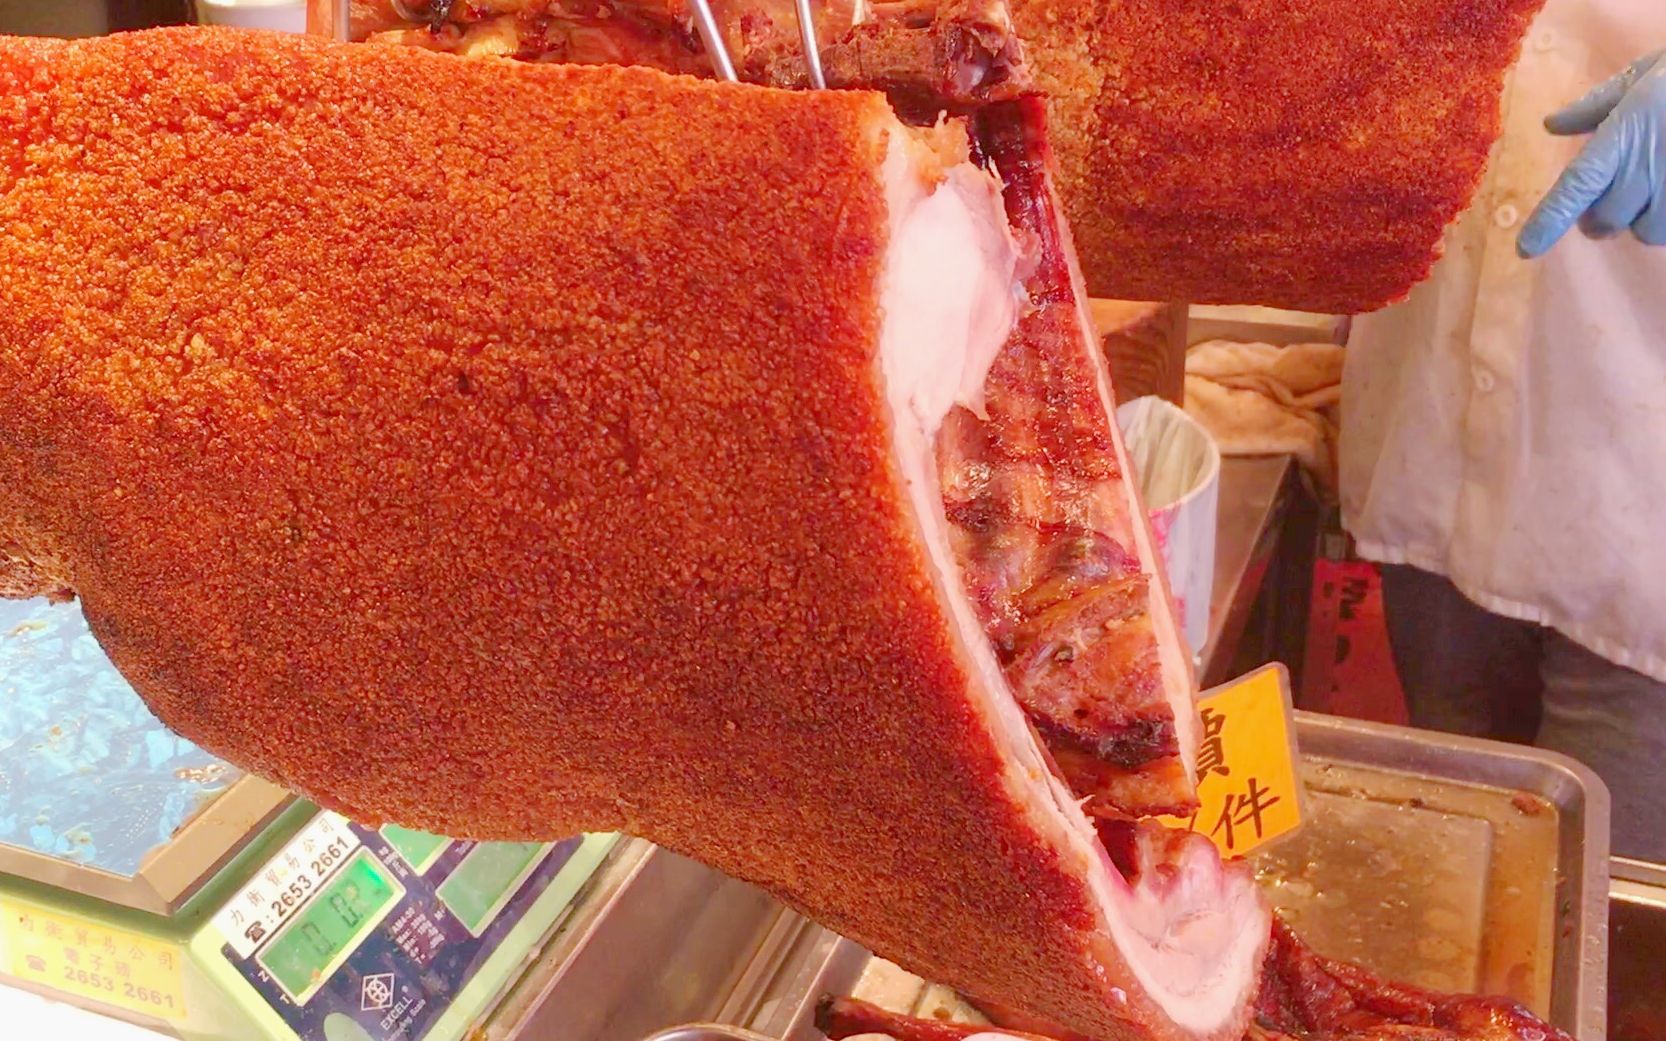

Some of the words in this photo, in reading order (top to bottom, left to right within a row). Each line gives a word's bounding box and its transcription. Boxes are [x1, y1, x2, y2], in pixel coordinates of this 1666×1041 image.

[271, 874, 312, 917] 2653
[311, 836, 349, 877] 2661
[63, 965, 116, 992] 2653
[122, 981, 175, 1009] 2661
[380, 996, 414, 1031] EXCELL
